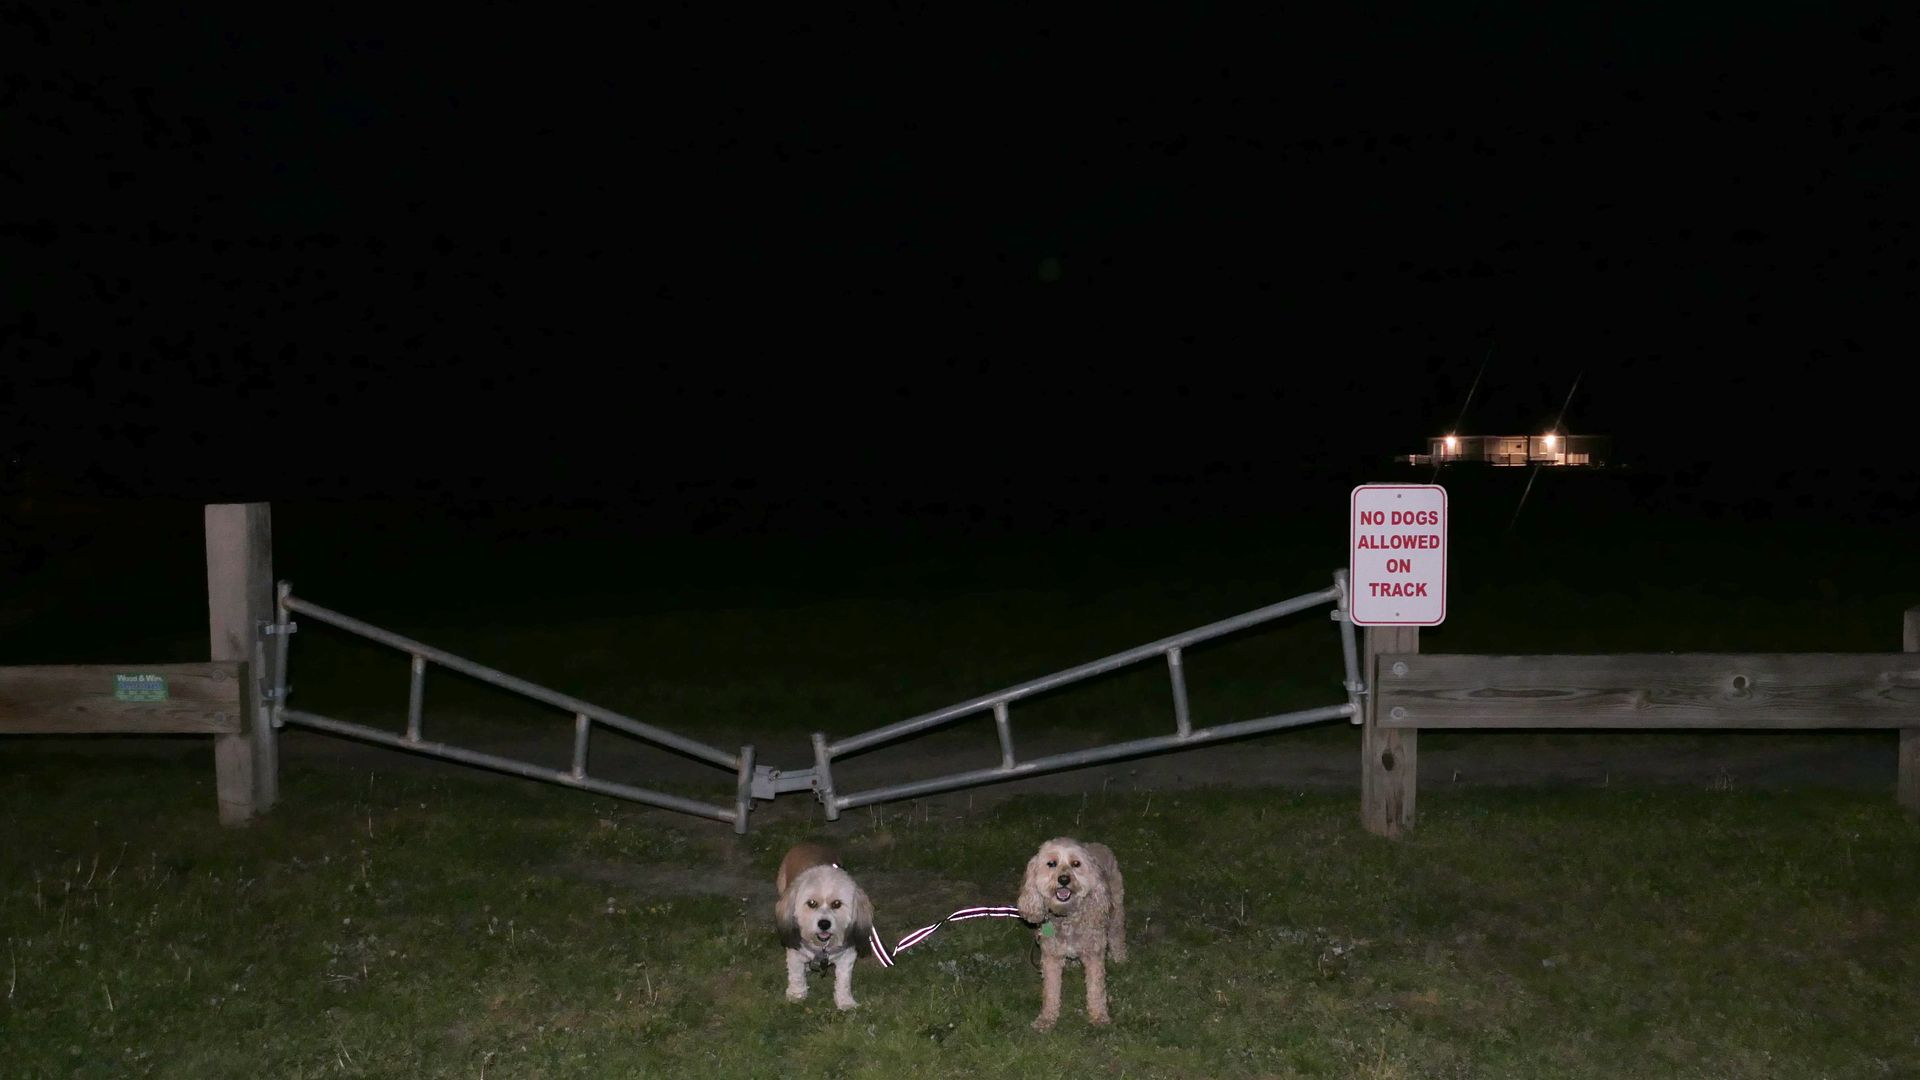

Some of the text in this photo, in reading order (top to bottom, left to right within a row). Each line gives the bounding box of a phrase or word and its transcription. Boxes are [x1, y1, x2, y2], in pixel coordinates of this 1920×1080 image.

[1360, 511, 1438, 525] NO DOGS
[1357, 535, 1440, 549] ALLOWED
[1386, 559, 1411, 573] ON
[1369, 583, 1427, 597] TRACK
[139, 674, 145, 682] &
